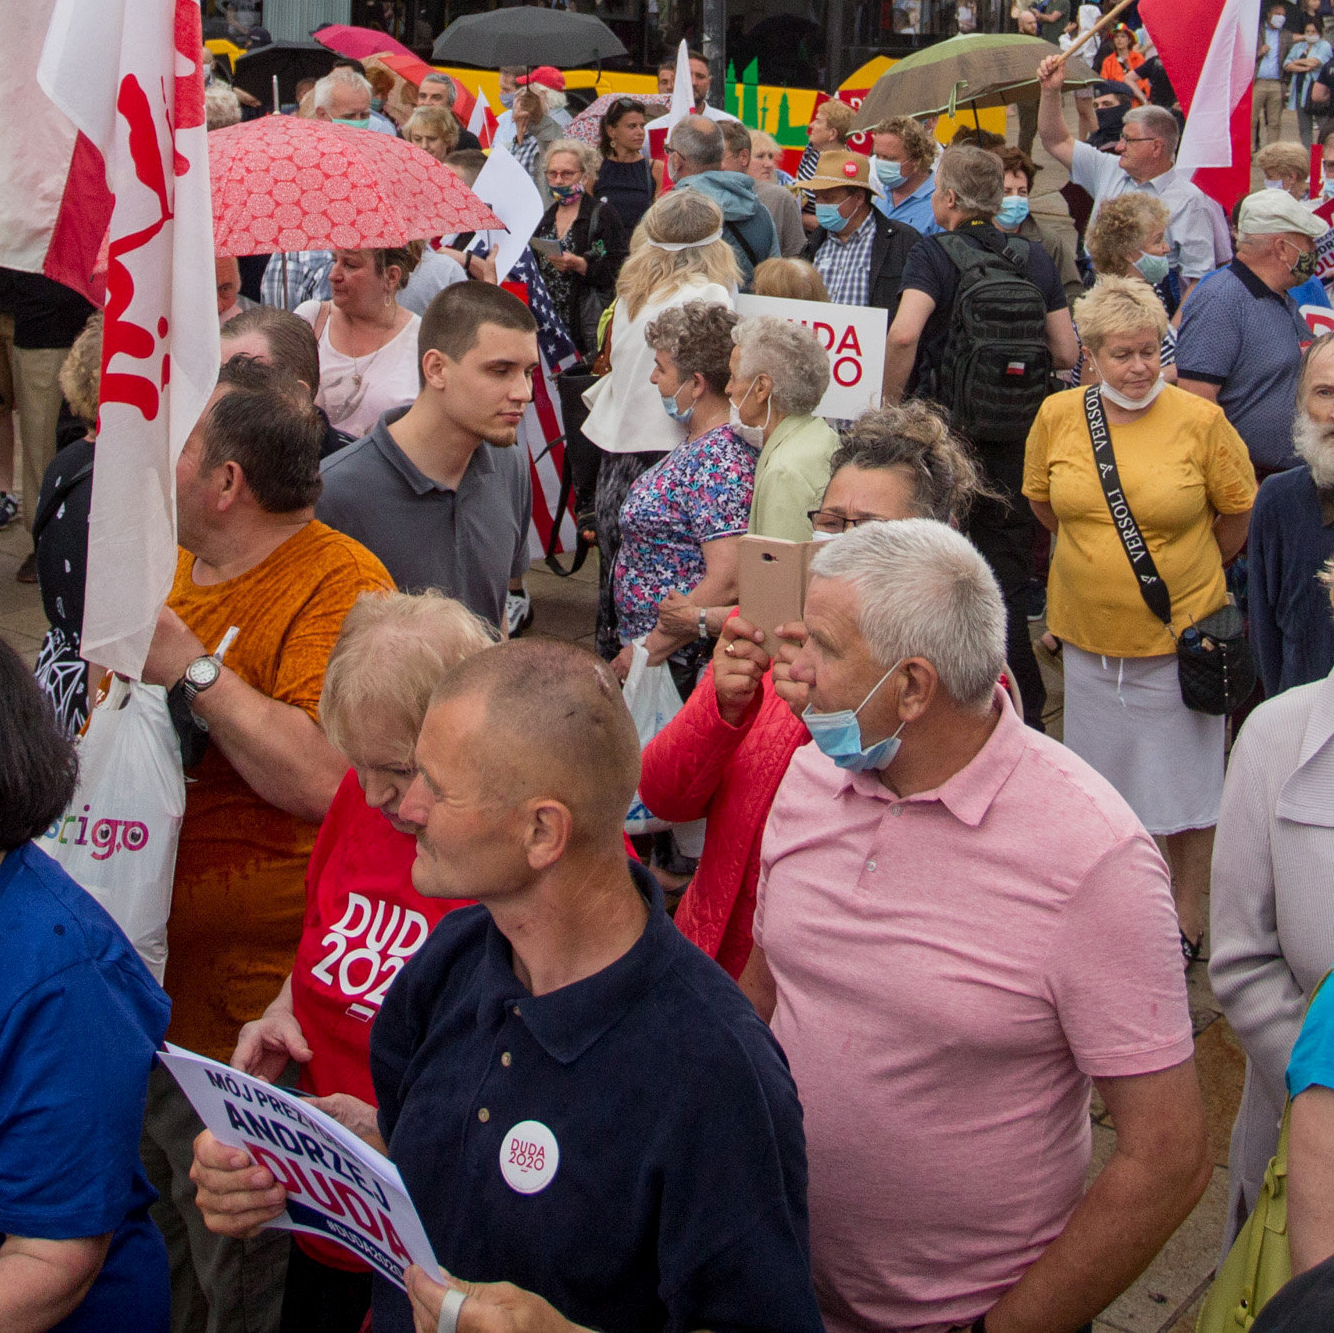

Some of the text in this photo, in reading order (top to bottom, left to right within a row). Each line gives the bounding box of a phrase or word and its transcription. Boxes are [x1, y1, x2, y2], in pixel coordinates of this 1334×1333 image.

[1085, 387, 1108, 452] VERSOLI
[1107, 488, 1146, 563] VERSOLI
[329, 891, 429, 958] DUD
[310, 932, 405, 1006] 202
[204, 1068, 253, 1103] MÓJ
[223, 1099, 392, 1213] ANDRZEJ
[508, 1151, 545, 1171] 2020
[510, 1138, 546, 1159] DUDA
[242, 1139, 415, 1266] DUDA
